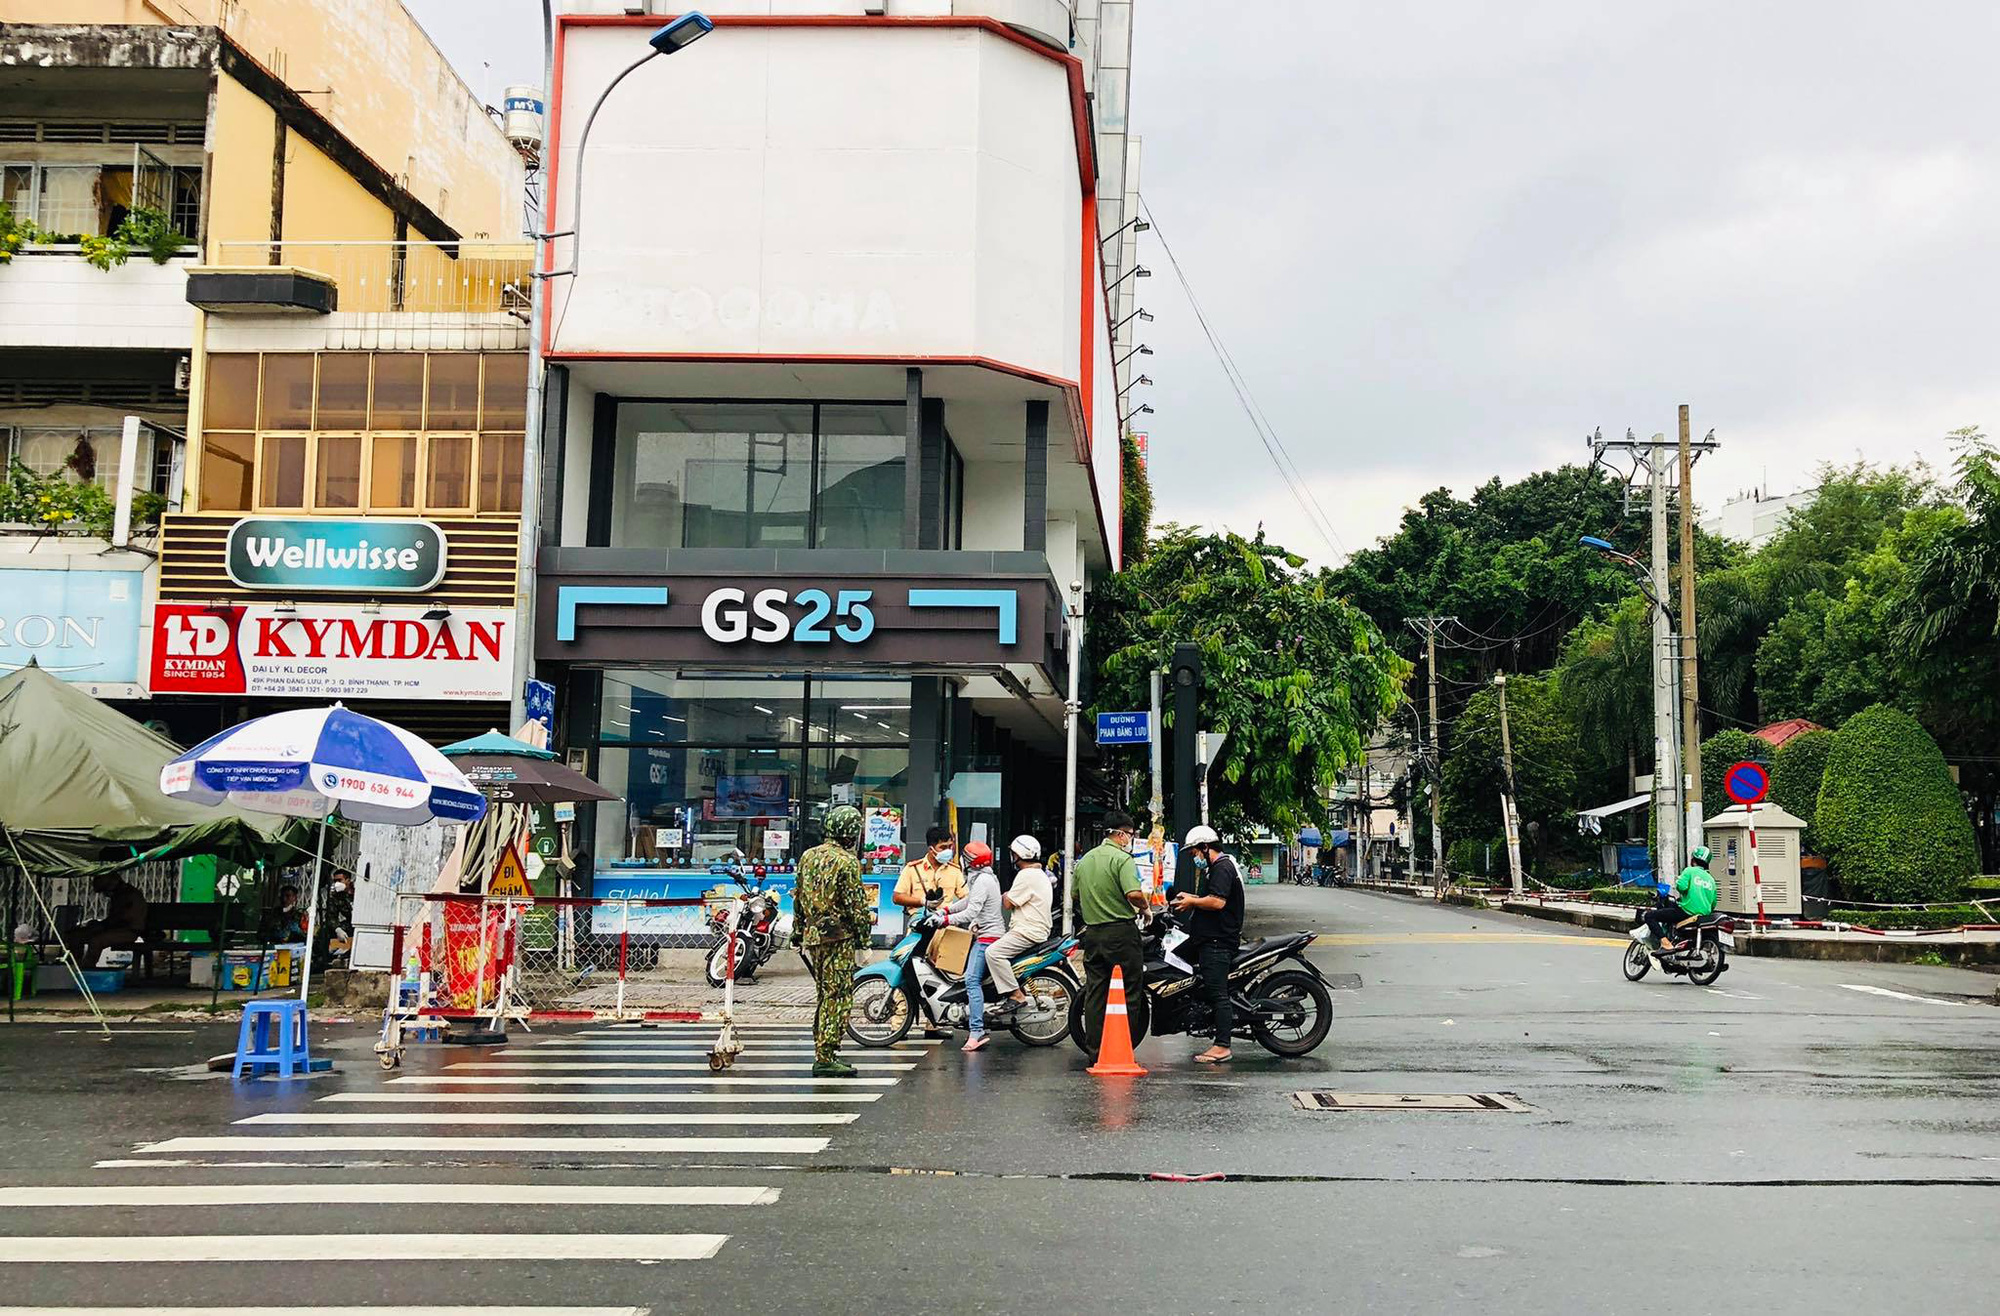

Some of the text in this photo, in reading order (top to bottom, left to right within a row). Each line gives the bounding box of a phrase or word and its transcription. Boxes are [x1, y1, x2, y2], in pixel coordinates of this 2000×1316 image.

[246, 537, 419, 571] Wellwisse
[701, 587, 875, 643] GS25
[254, 617, 505, 662] KYMDAN
[164, 660, 226, 672] KYMDAN
[283, 665, 294, 673] KL
[297, 666, 328, 675] DECOR
[163, 671, 226, 679] SINCE 1954
[126, 687, 133, 696] 2
[1110, 714, 1136, 724] ĐƯỜNG
[1099, 726, 1148, 738] PHAN ĐĂNG LƯU
[464, 773, 518, 781] GS25
[340, 777, 415, 799] 1900 636 944
[503, 866, 514, 879] ĐI
[1694, 876, 1714, 891] Grab
